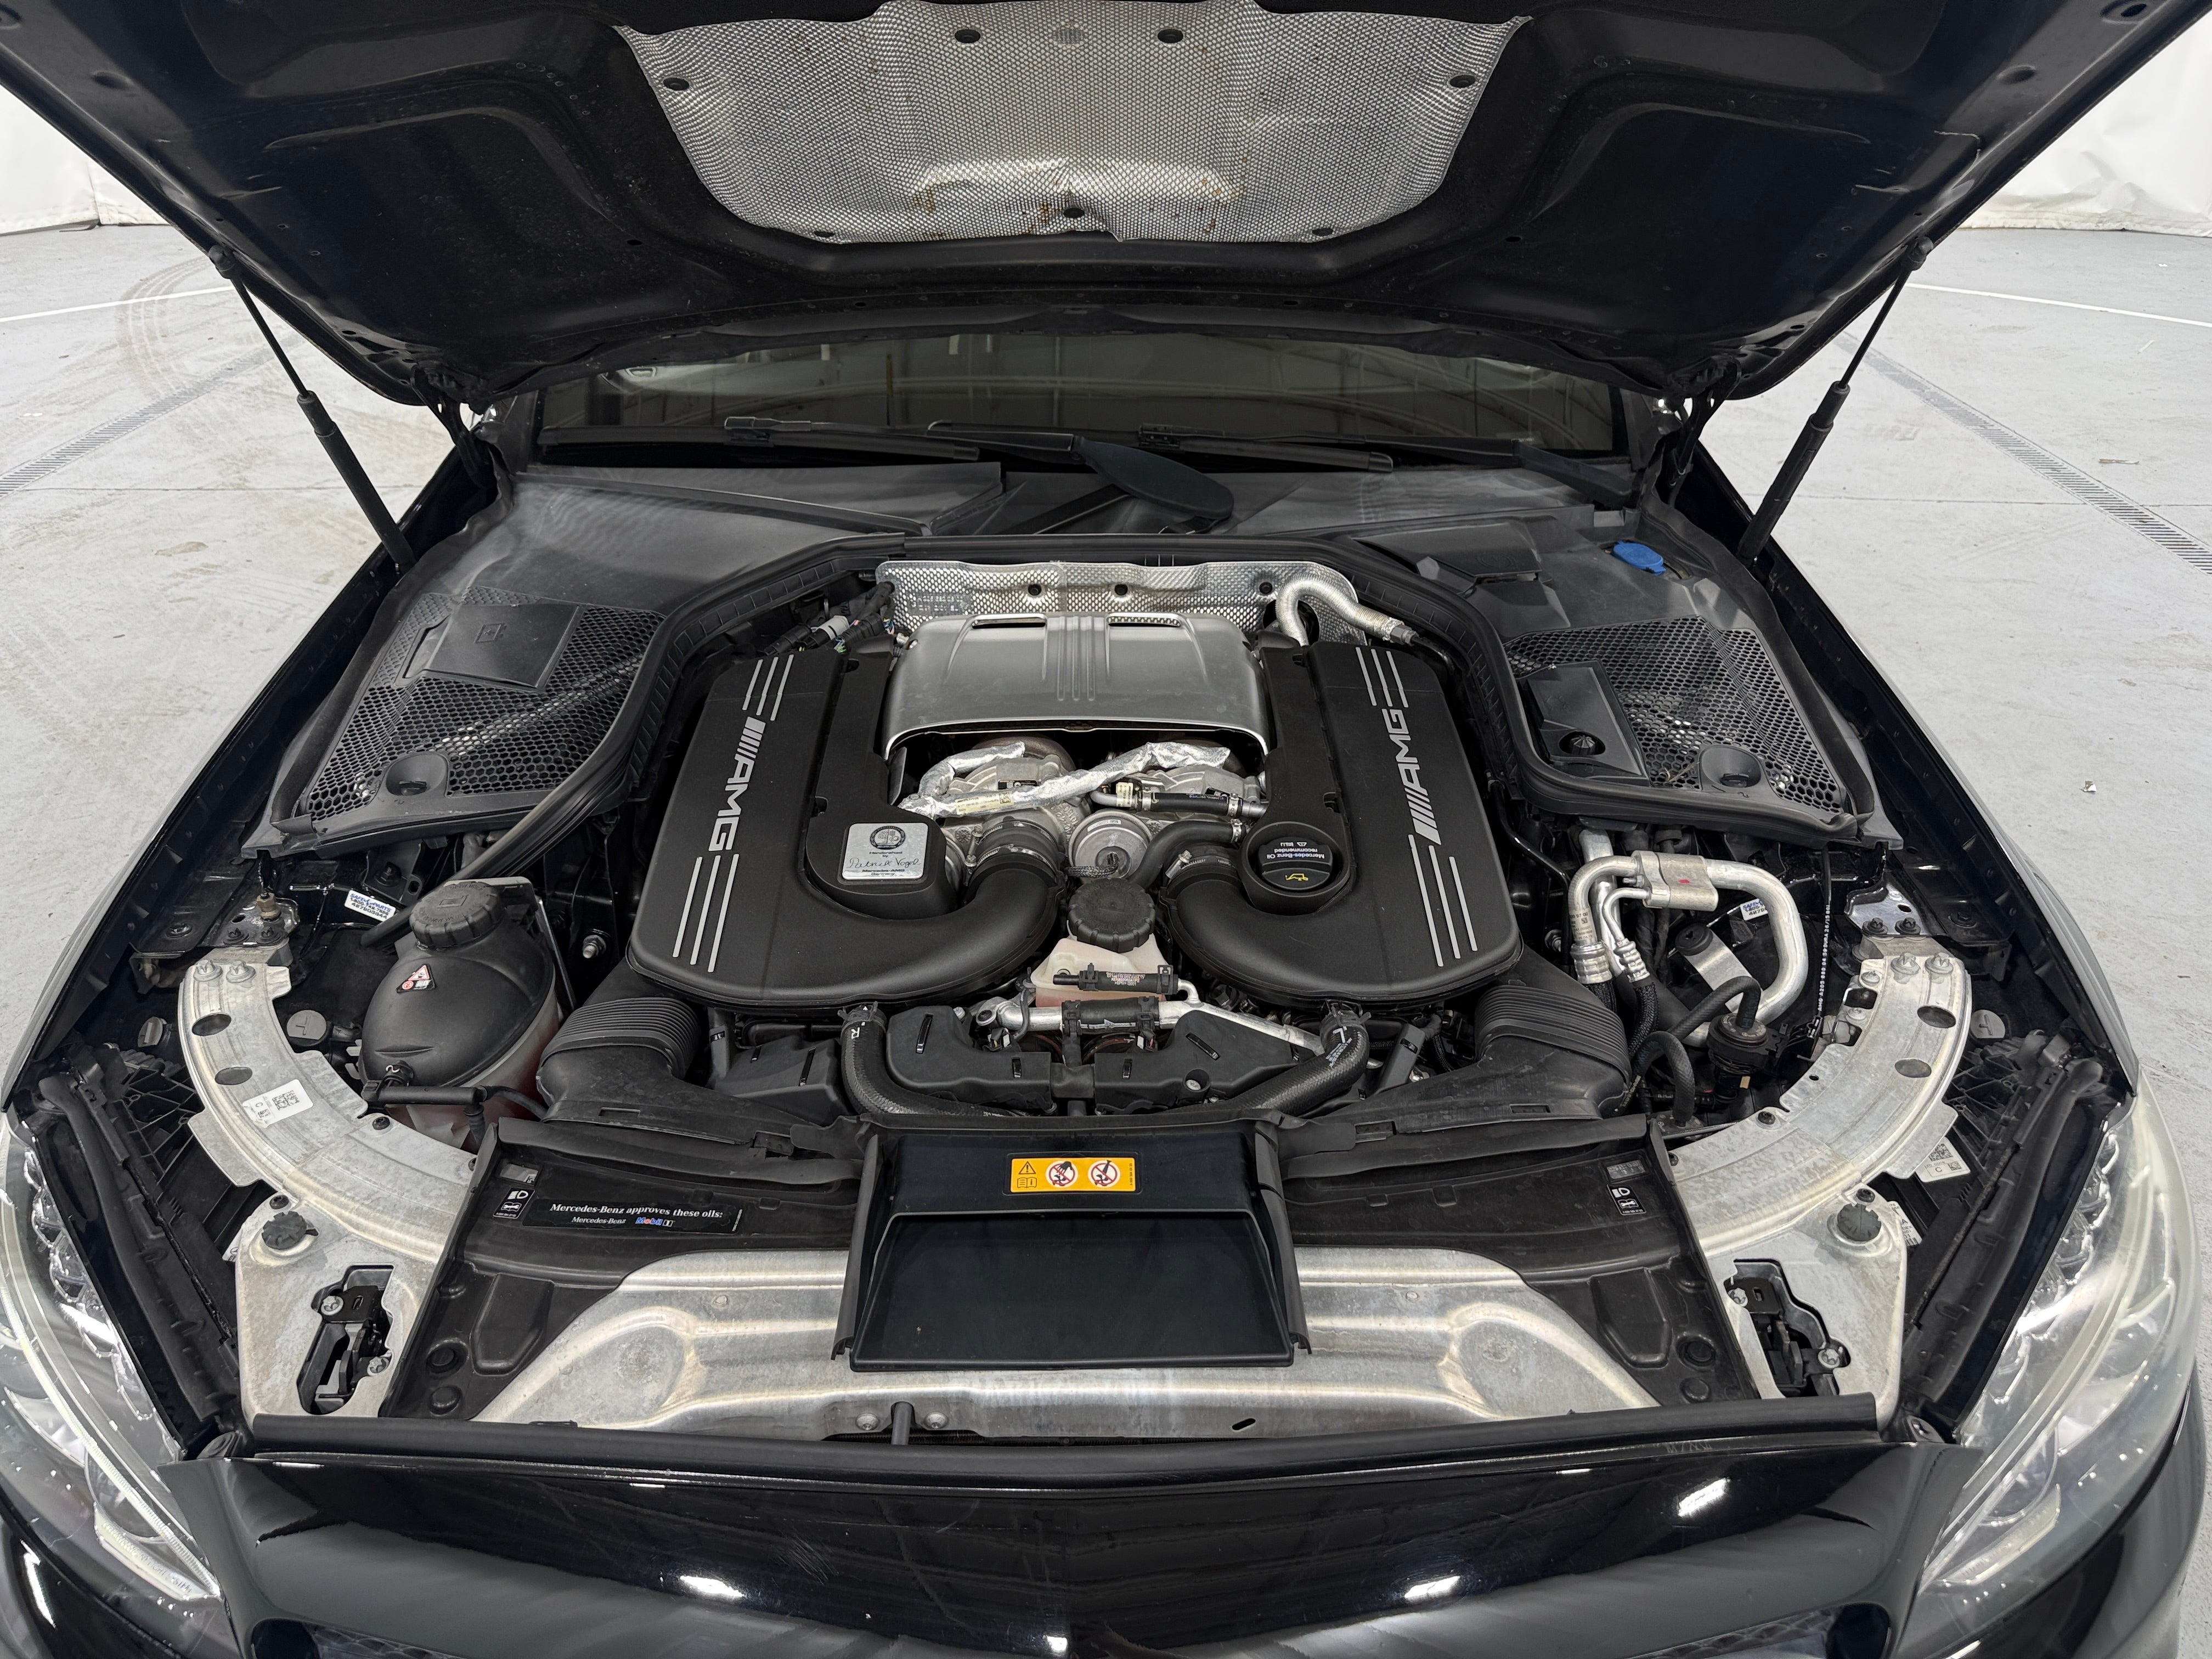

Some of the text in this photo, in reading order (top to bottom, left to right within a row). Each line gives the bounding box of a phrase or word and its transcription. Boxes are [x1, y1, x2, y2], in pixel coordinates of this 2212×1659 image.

[1381, 708, 1428, 796] AMG
[708, 753, 755, 851] AMG
[549, 1204, 724, 1218] Mercedes-Benz approves these oils:
[571, 1216, 627, 1224] Mercedes-Benz
[635, 1216, 663, 1225] Mobil
